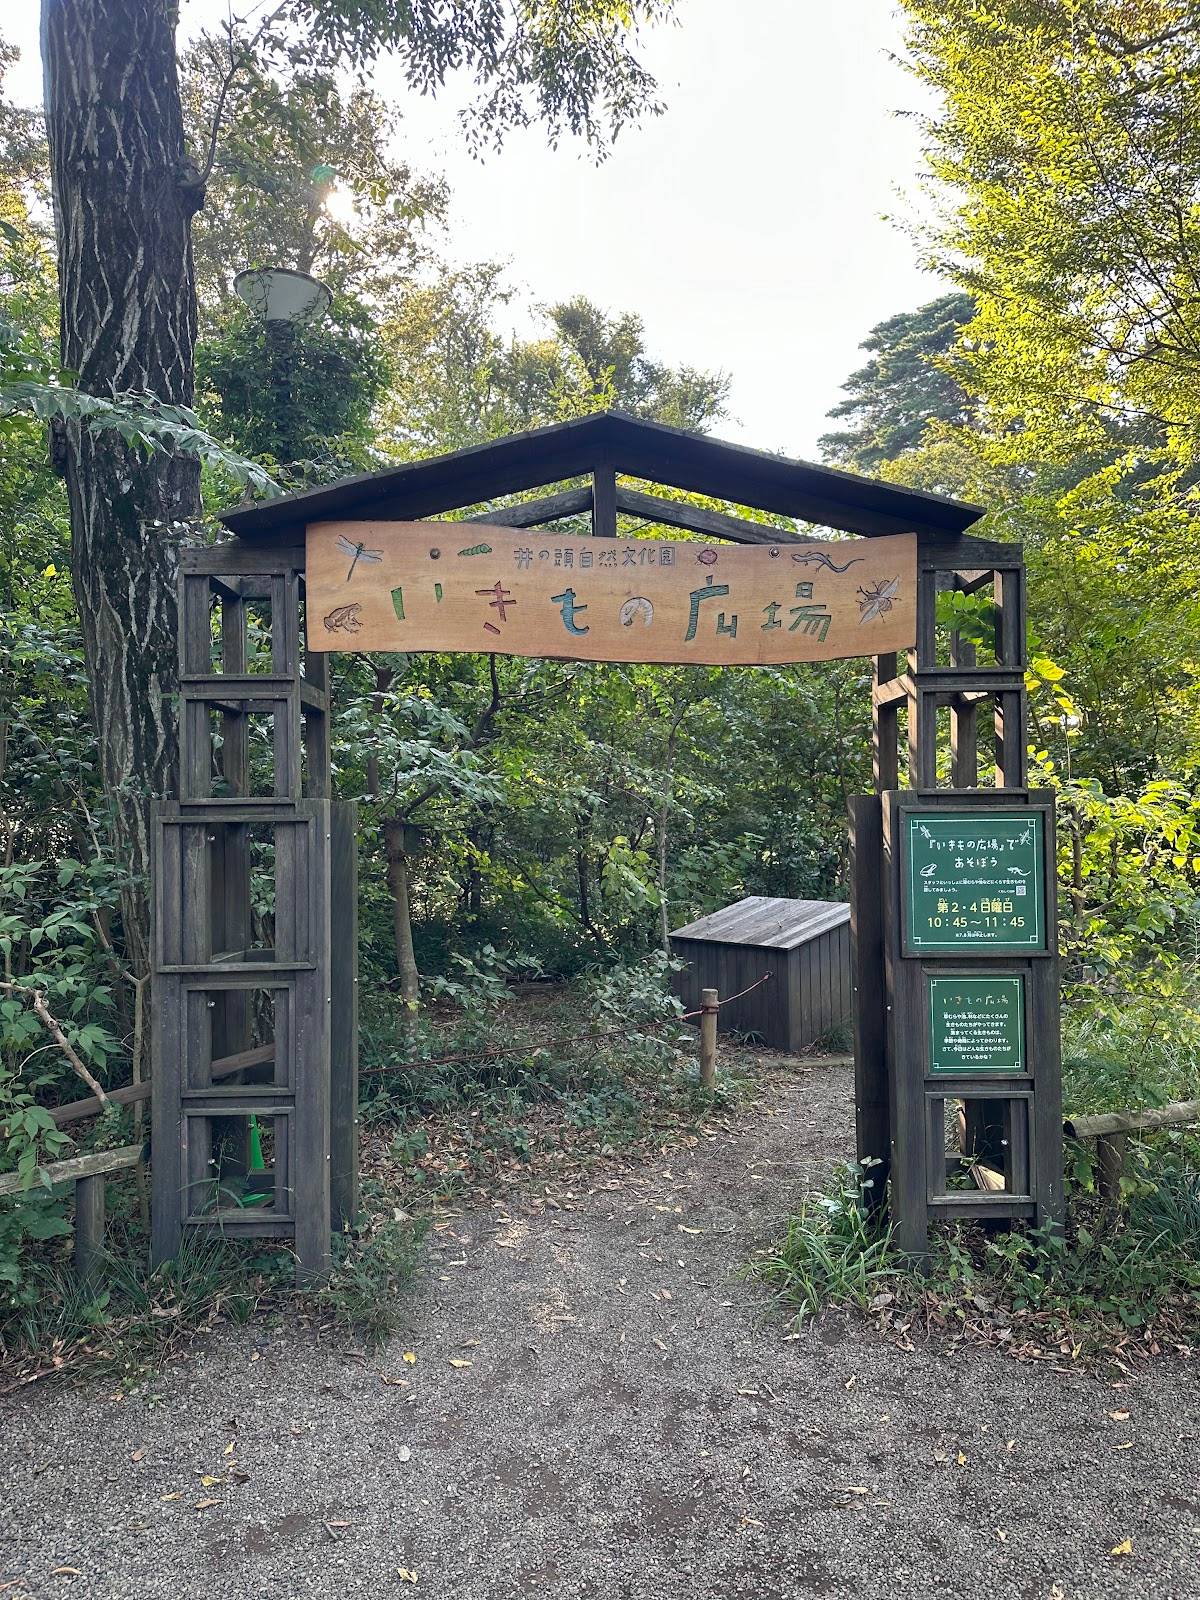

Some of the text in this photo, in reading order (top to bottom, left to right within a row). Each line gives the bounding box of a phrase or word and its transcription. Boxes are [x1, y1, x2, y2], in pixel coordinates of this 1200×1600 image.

[513, 546, 676, 570] 井の頭自然文化園
[390, 574, 832, 643] いきもの広場
[954, 856, 998, 869] あそぼう
